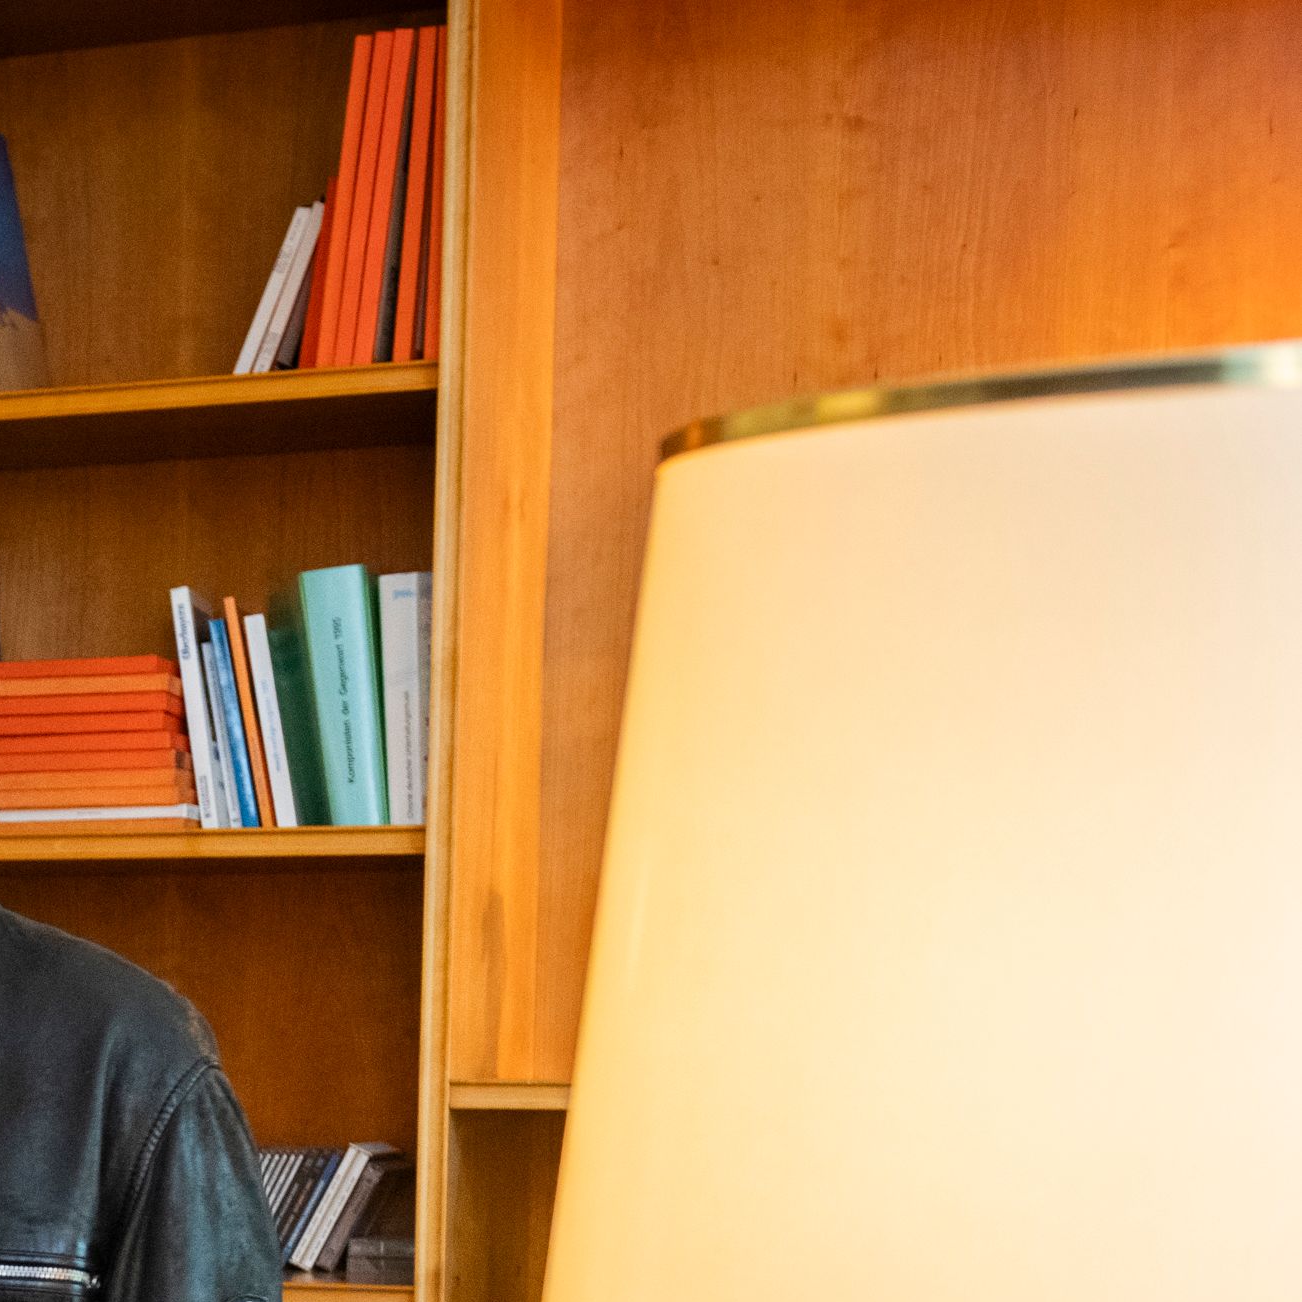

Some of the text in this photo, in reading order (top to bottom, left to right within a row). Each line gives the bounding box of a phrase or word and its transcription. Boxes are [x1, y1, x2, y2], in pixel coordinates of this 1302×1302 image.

[336, 643, 349, 696] Gegenwart
[341, 700, 350, 716] der
[342, 719, 355, 784] Komponisten
